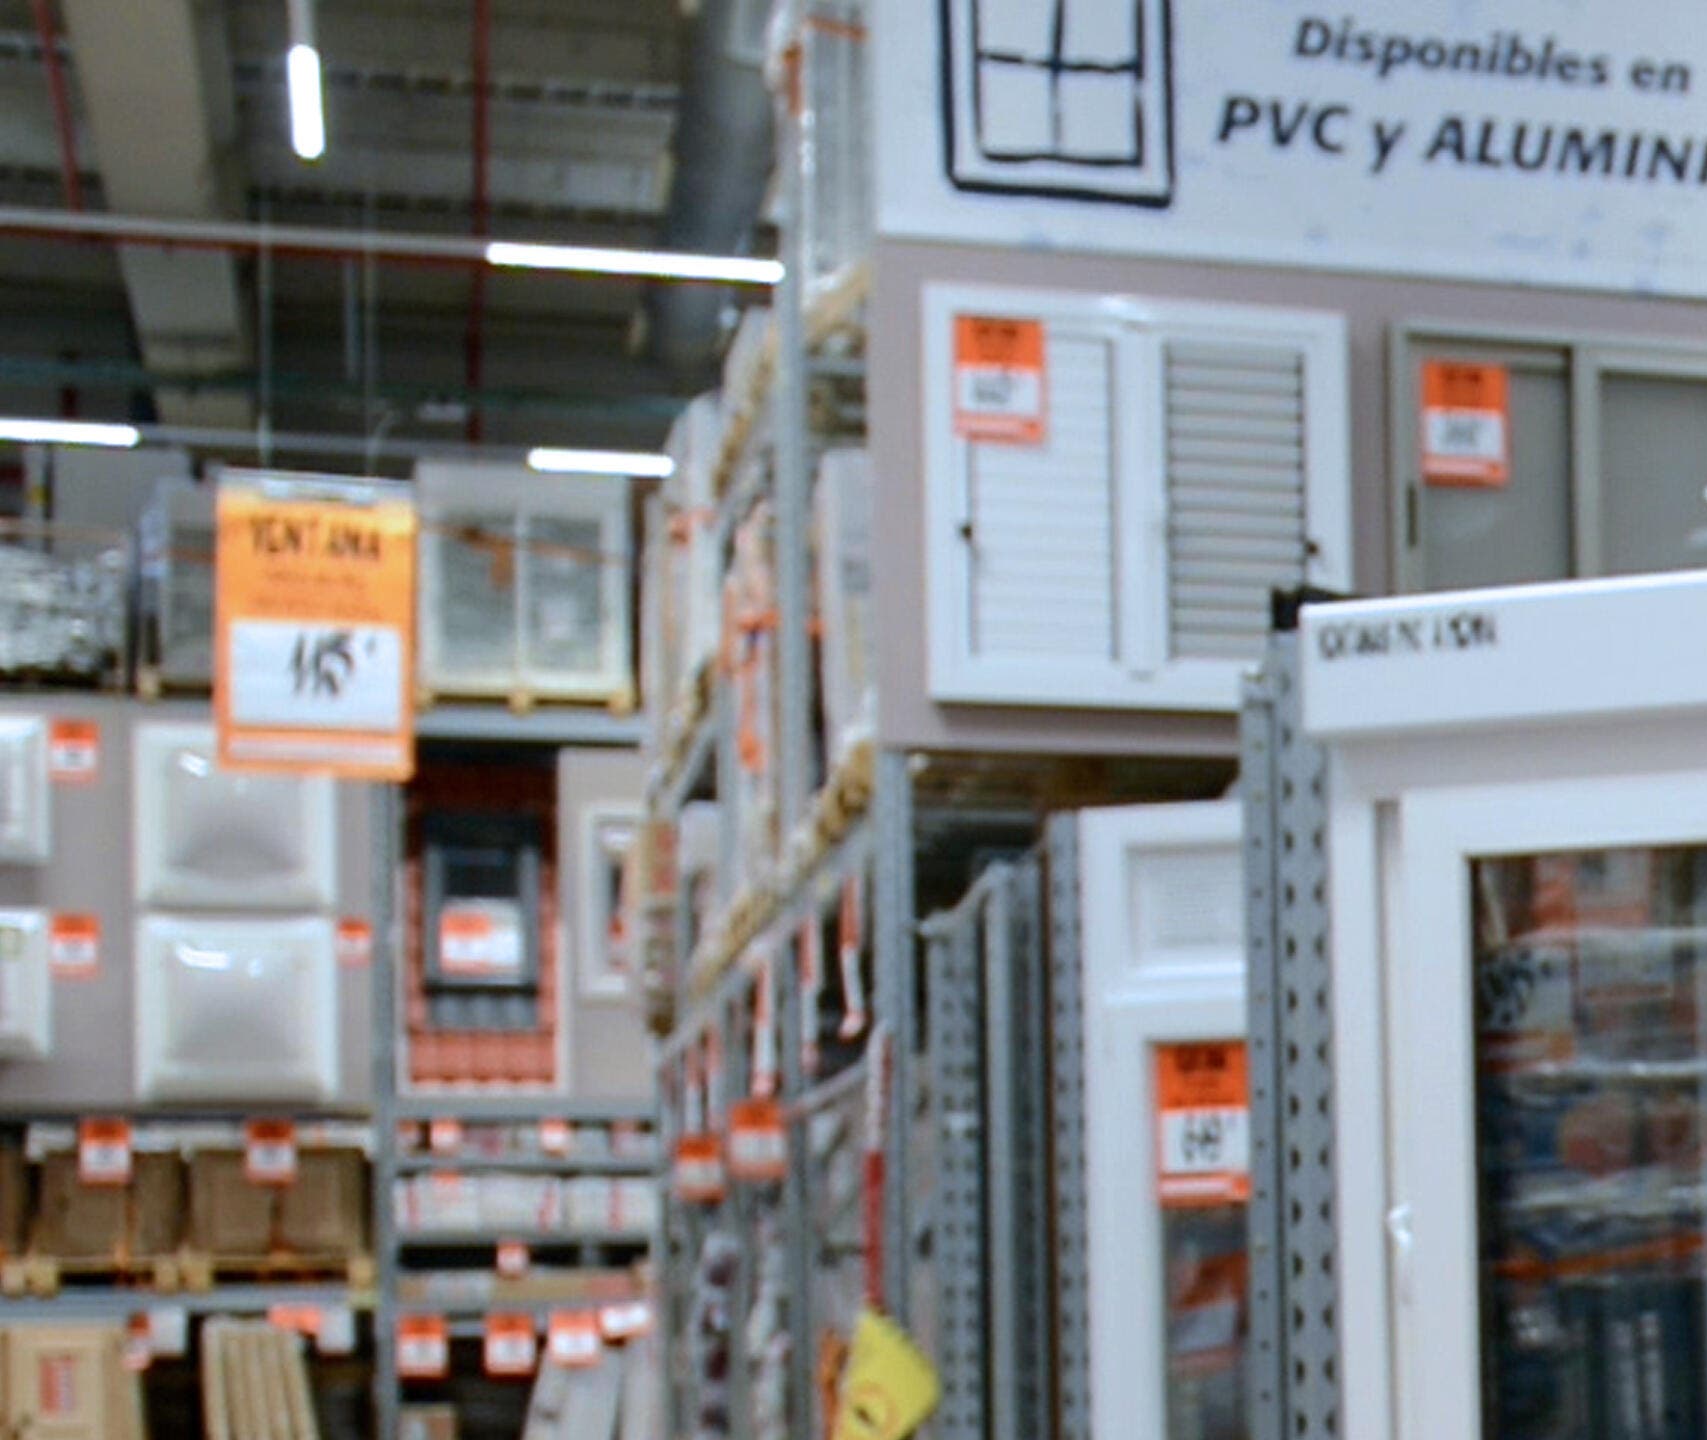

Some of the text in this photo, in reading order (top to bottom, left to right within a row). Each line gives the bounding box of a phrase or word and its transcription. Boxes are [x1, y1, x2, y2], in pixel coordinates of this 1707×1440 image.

[1292, 16, 1691, 95] Disponibles en
[1215, 96, 1349, 154] PVC
[1371, 122, 1405, 174] y
